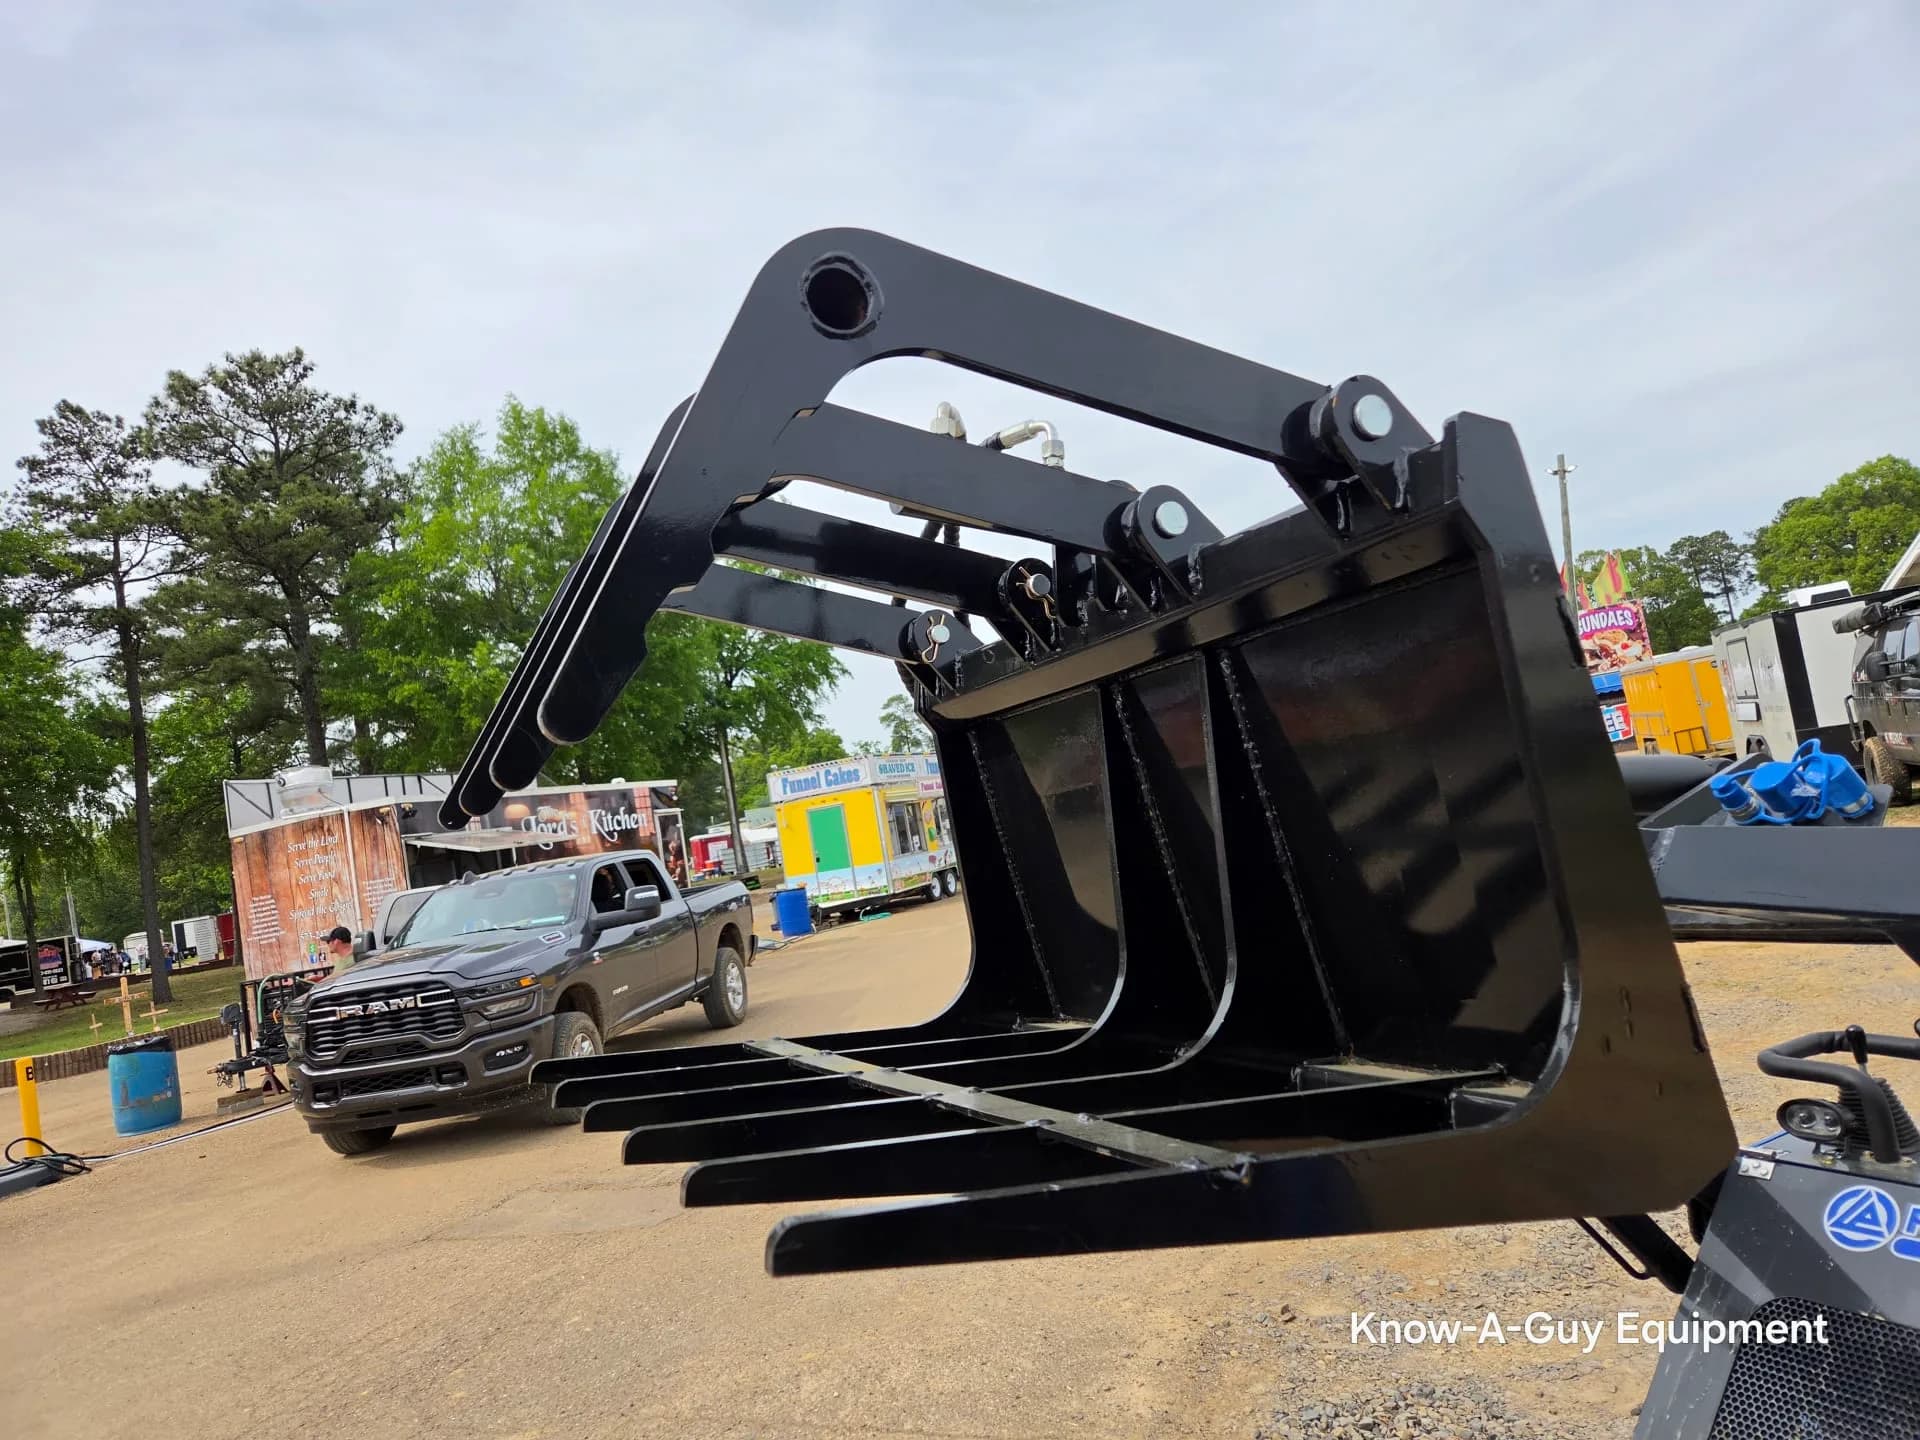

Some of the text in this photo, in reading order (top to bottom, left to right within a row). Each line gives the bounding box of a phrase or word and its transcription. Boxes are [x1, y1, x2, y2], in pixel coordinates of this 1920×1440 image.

[878, 762, 916, 774] SHAVED ICE
[781, 766, 860, 795] Funnel Cakes
[585, 806, 648, 842] Kitchen
[287, 841, 307, 853] Serve
[320, 832, 338, 846] Lord
[294, 850, 337, 869] Serve People
[298, 872, 317, 885] Serve
[338, 995, 416, 1019] RAM
